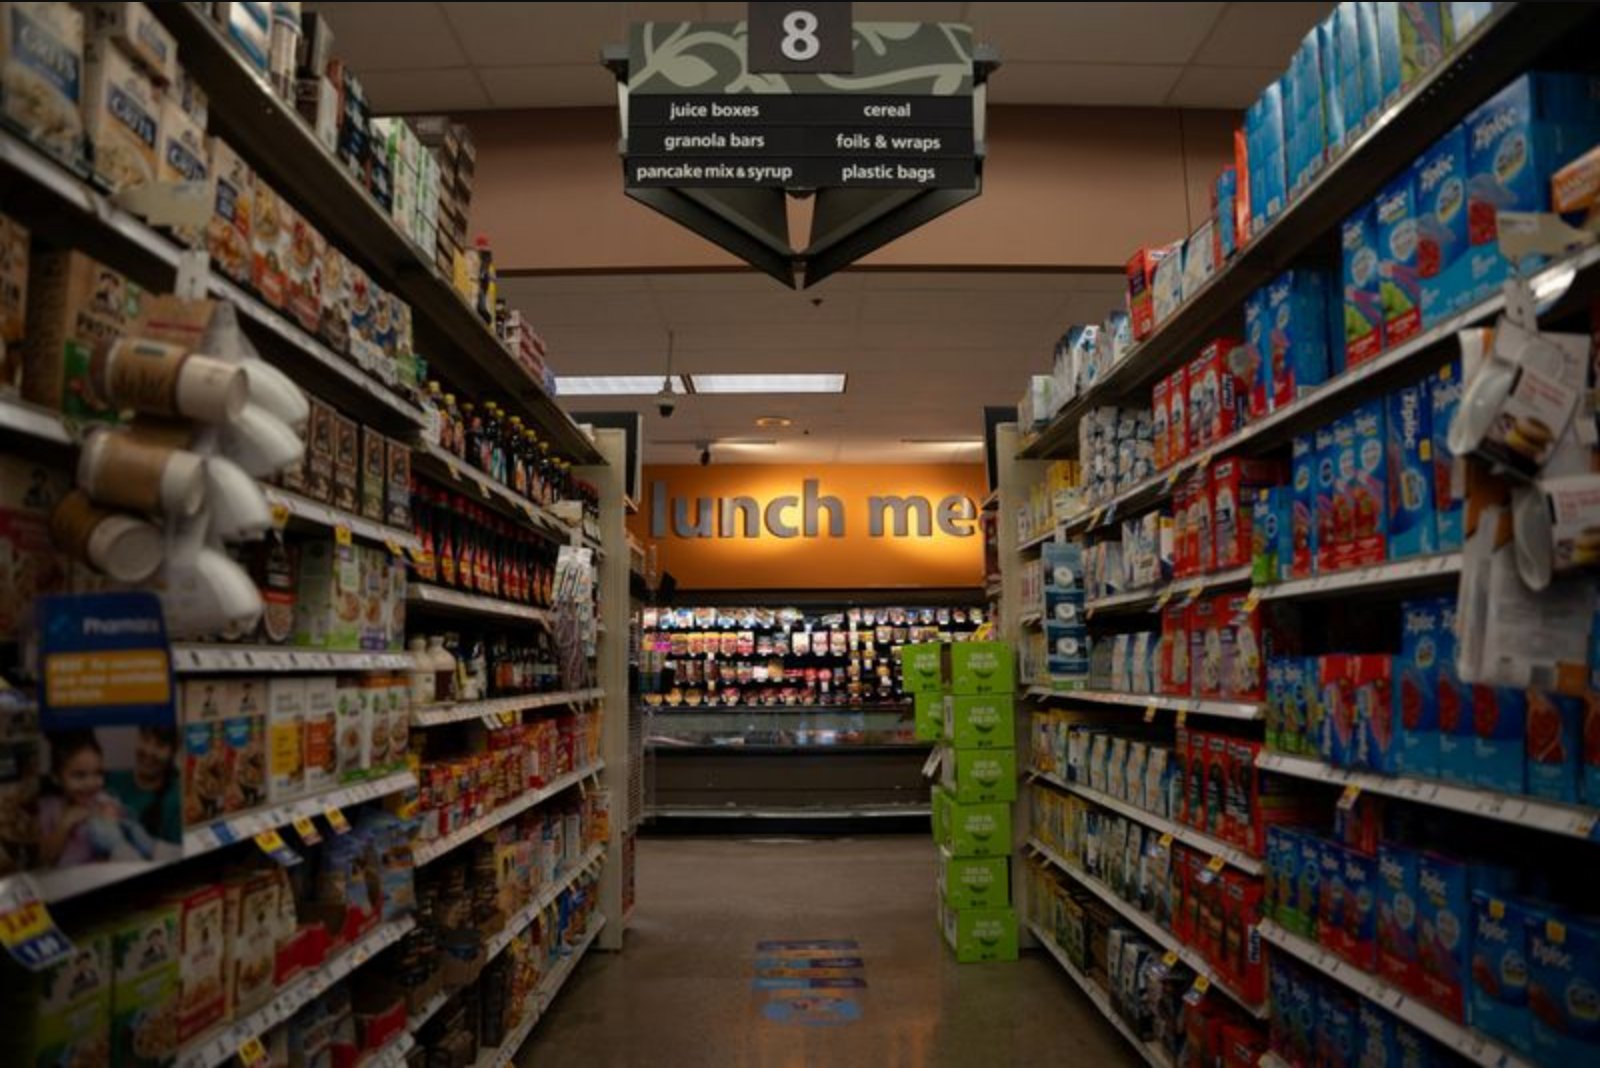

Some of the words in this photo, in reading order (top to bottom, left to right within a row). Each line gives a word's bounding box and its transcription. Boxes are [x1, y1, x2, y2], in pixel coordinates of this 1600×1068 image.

[781, 10, 820, 61] 8
[669, 102, 708, 121] juice
[711, 102, 760, 117] boxes
[863, 102, 911, 117] cereal
[664, 132, 726, 151] granola
[730, 132, 765, 147] bars
[836, 133, 871, 149] foils
[874, 134, 887, 149] &
[891, 137, 941, 153] wraps
[636, 163, 703, 181] pancake
[704, 163, 735, 178] mix
[735, 167, 746, 178] &
[747, 166, 793, 182] syrup
[841, 163, 894, 182] plastic
[897, 163, 936, 183] bags
[649, 479, 845, 538] lunch
[868, 494, 984, 538] me
